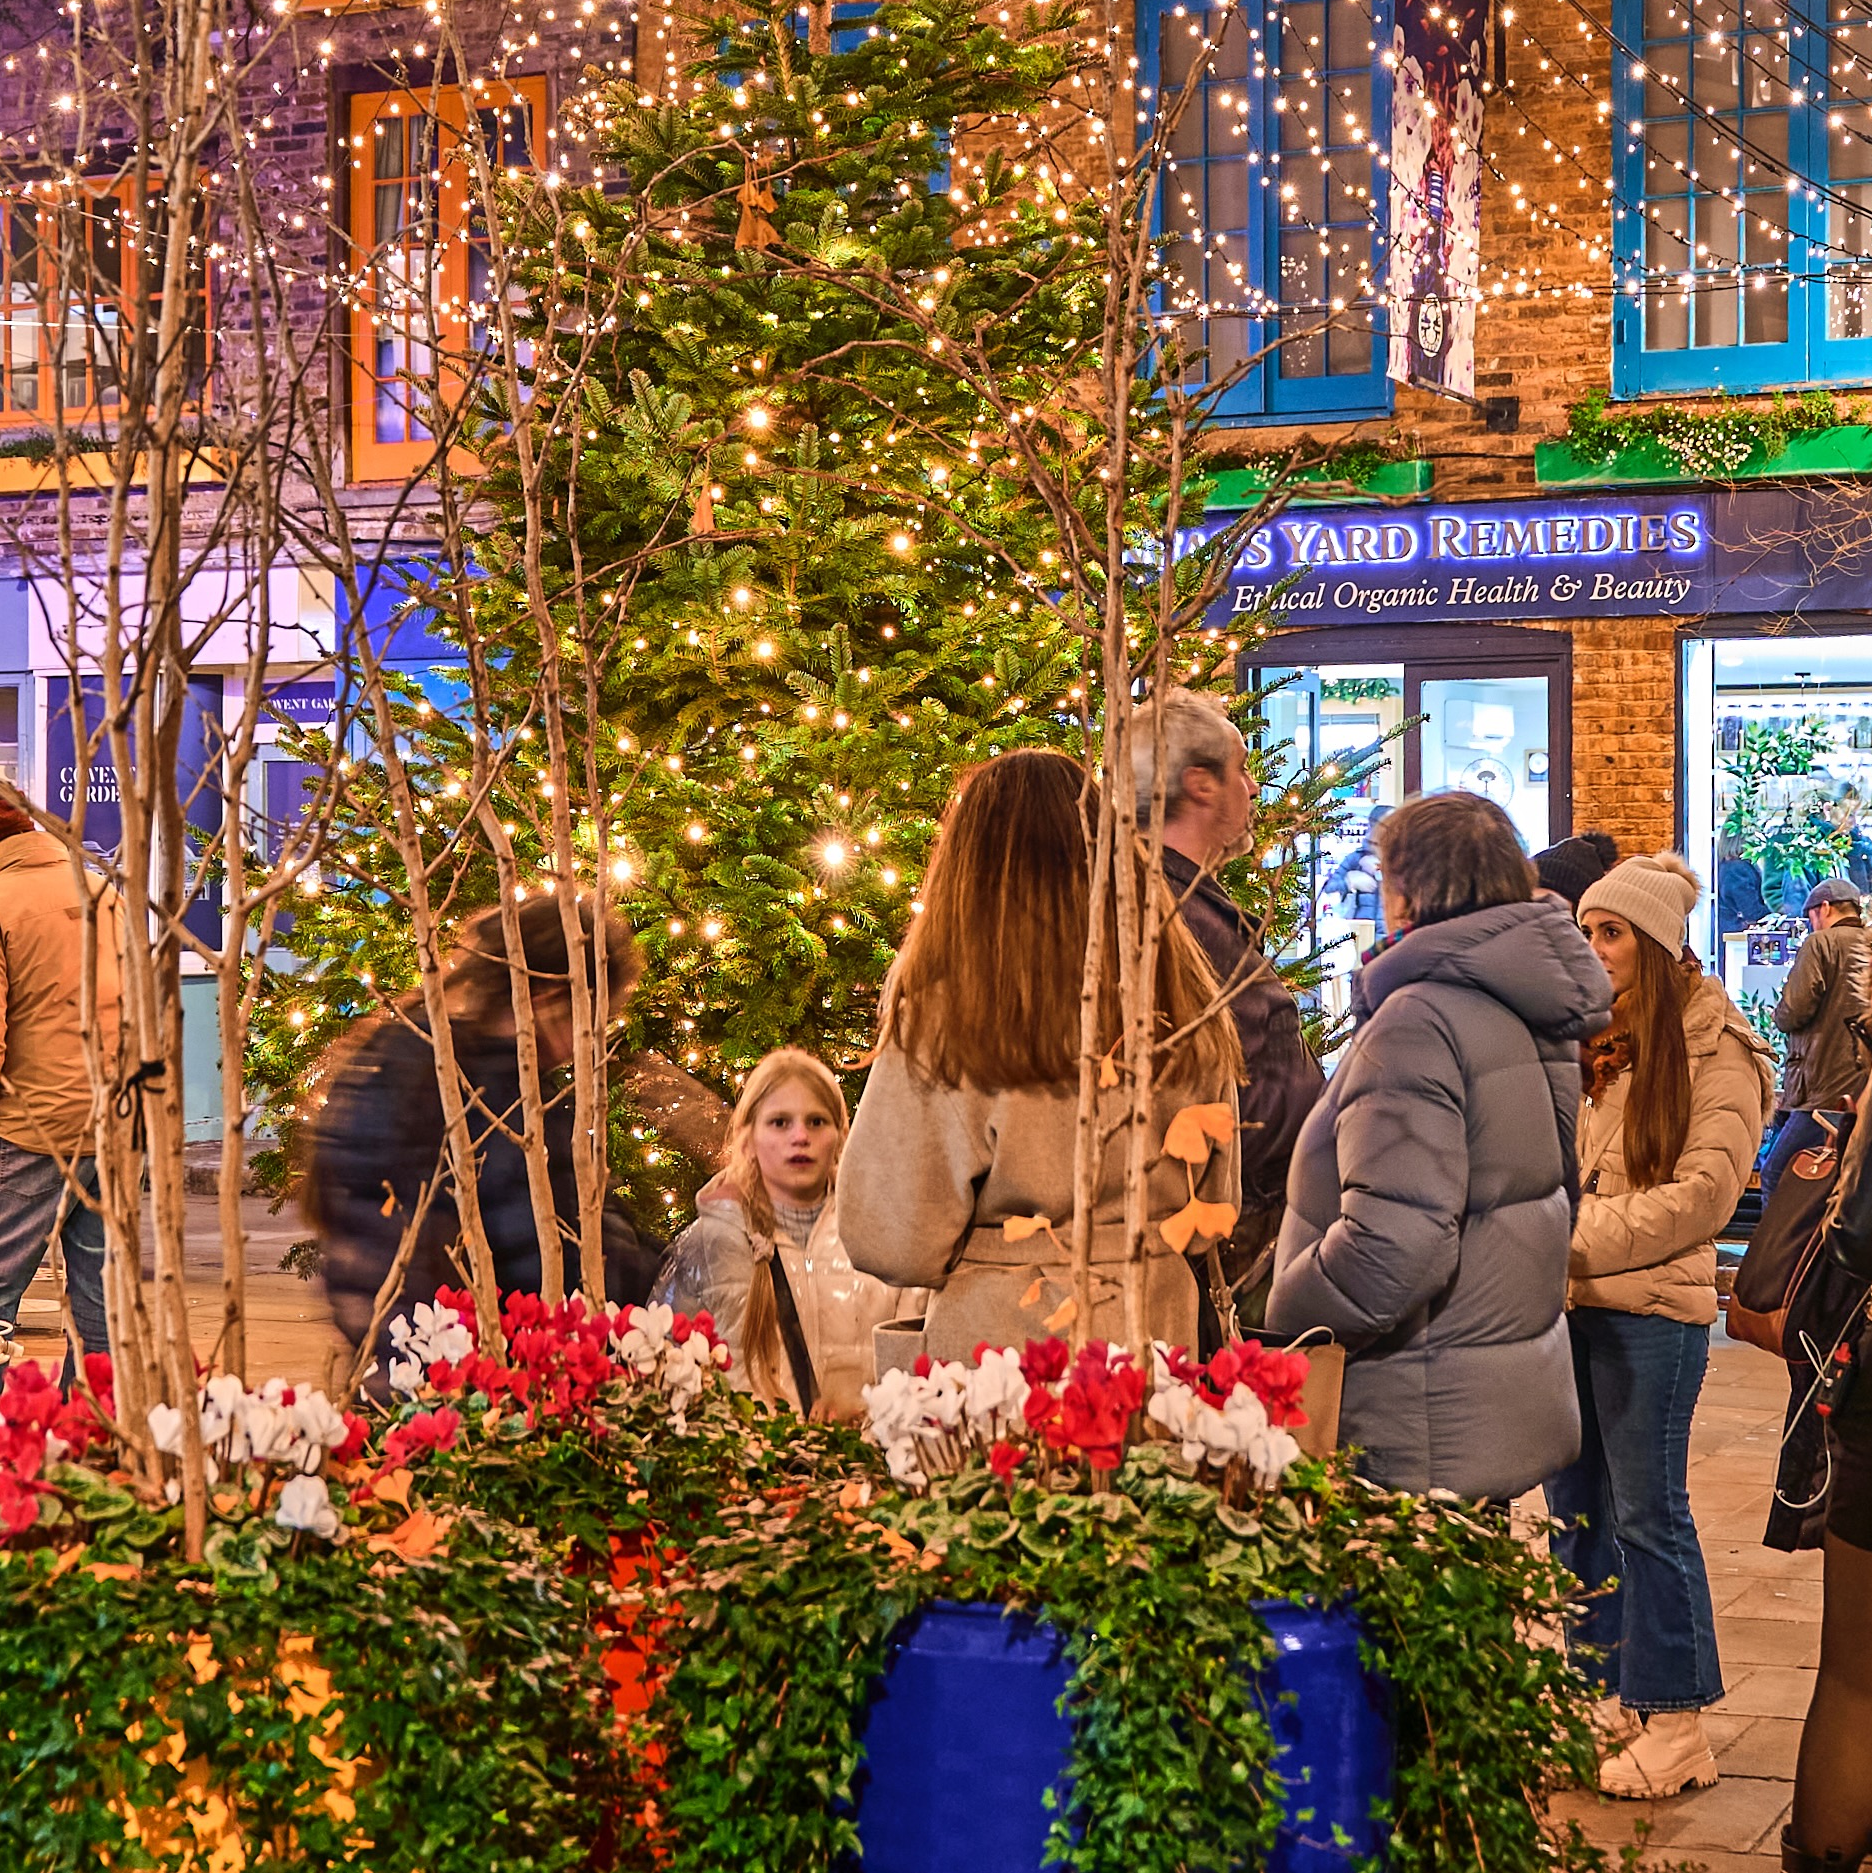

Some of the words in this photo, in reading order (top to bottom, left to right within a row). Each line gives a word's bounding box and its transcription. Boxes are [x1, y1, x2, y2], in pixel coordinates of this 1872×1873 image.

[1281, 522, 1416, 564] YARD
[1428, 513, 1699, 560] REMEDIES
[1334, 579, 1439, 613] Organic
[1447, 576, 1539, 605] Health
[1550, 573, 1583, 601] &
[1590, 572, 1691, 605] Beauty
